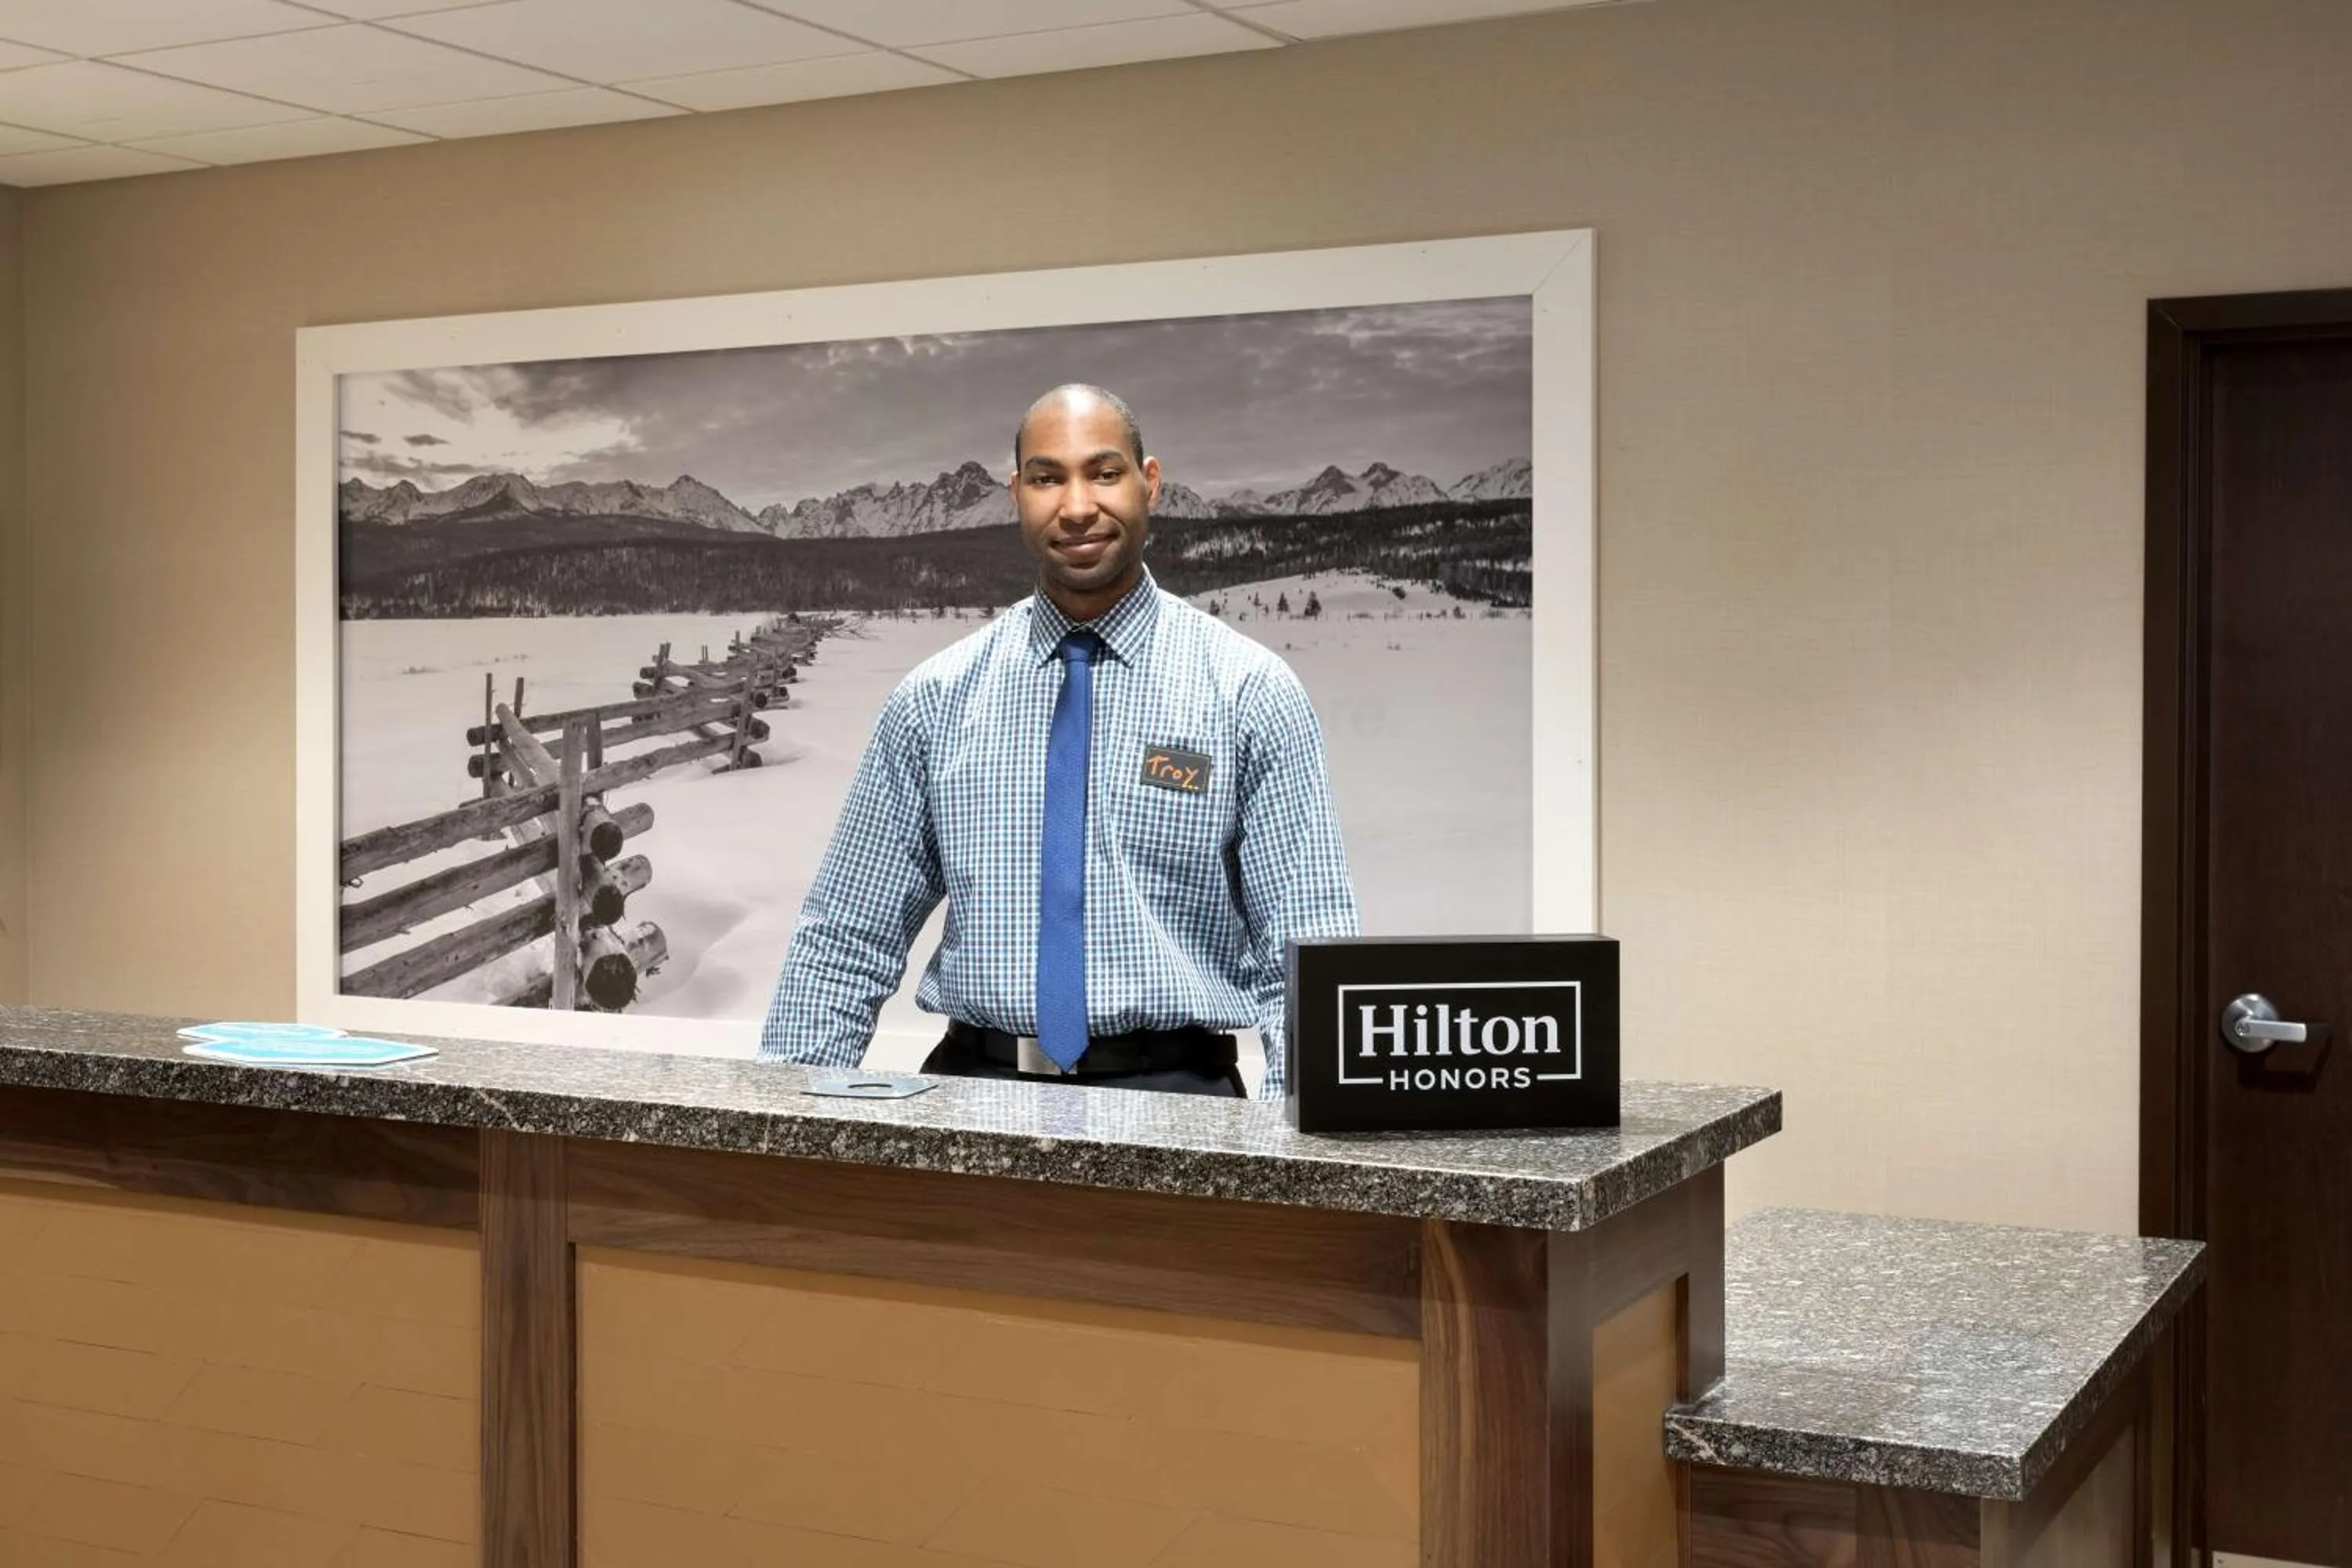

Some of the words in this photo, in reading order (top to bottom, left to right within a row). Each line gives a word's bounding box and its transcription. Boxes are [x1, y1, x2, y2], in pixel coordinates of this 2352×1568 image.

[1145, 754, 1200, 788] Troy
[1359, 1004, 1561, 1057] Hilton
[1390, 1067, 1531, 1091] HONORS
